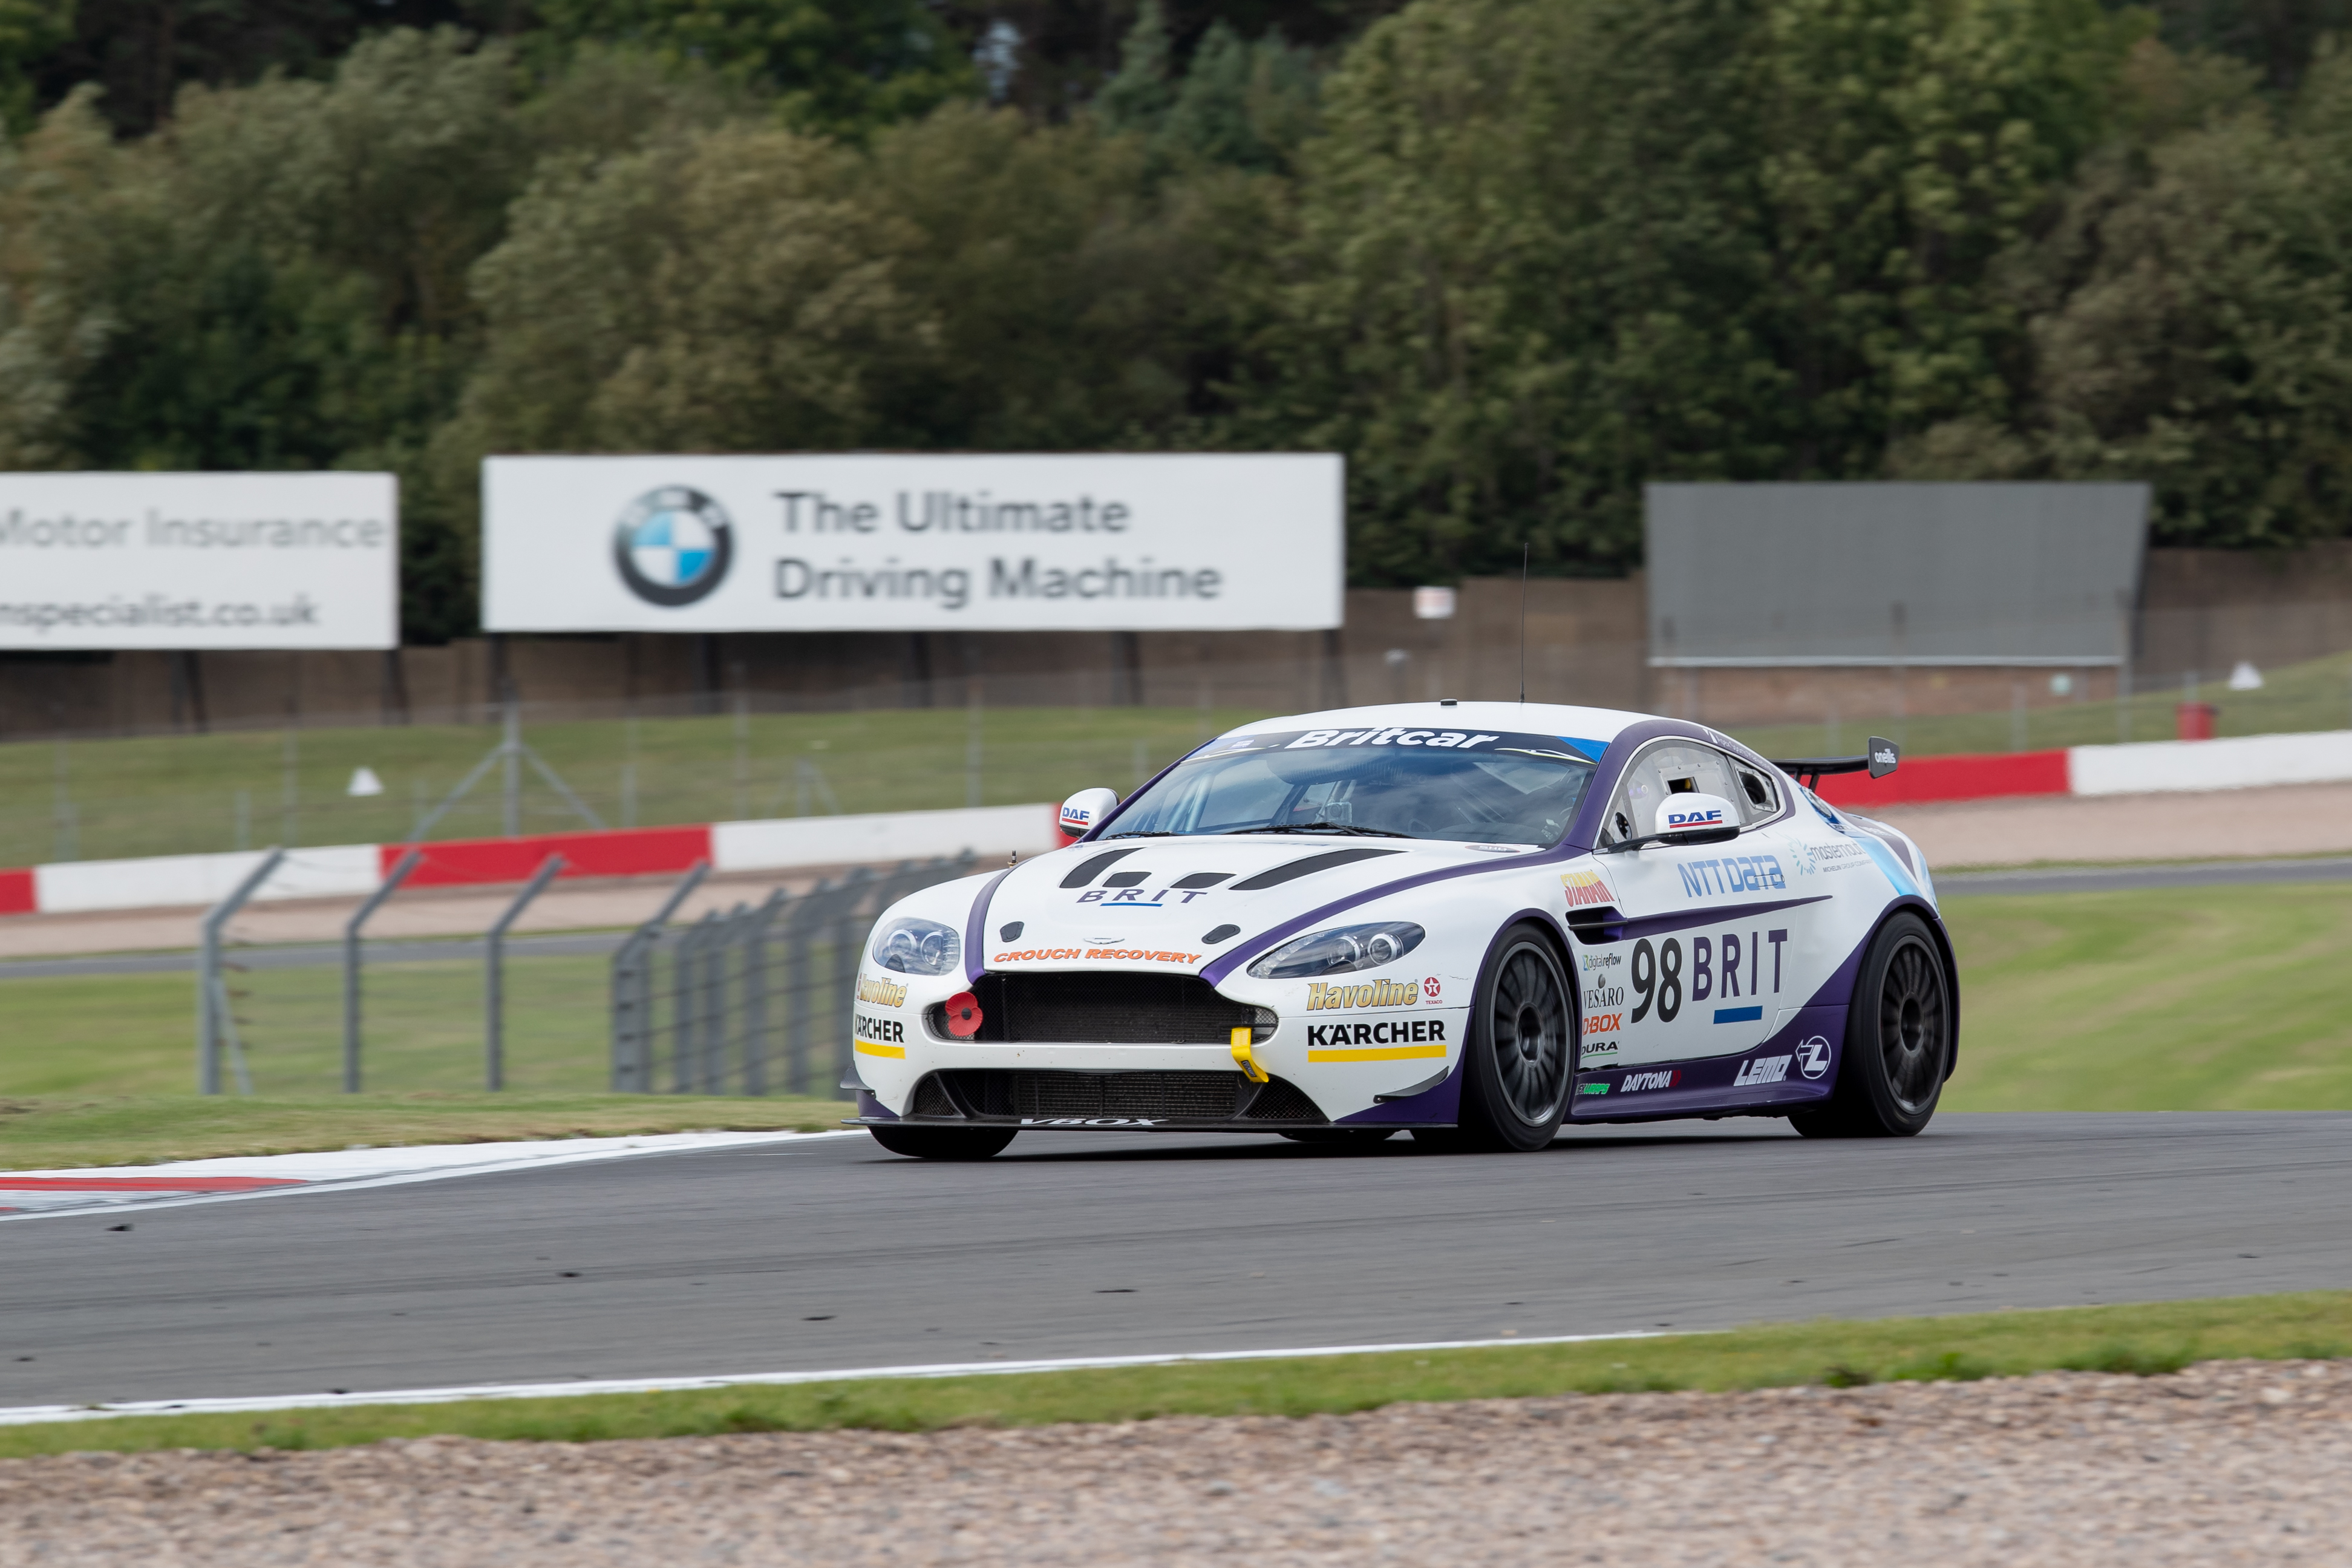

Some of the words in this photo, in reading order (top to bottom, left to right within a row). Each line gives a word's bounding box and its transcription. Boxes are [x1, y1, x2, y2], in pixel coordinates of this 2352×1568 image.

[775, 489, 878, 533] The
[897, 489, 1129, 533] Ultimate
[145, 508, 385, 548] Insurance
[775, 557, 968, 609] Driving
[988, 557, 1223, 599] Machine
[1284, 727, 1500, 749] Britcar
[1062, 806, 1090, 820] DAF
[1668, 809, 1722, 824] DAF
[1677, 859, 1725, 898] NTT
[1076, 889, 1207, 903] BRIT
[994, 949, 1081, 962] CROUCH
[1085, 949, 1201, 964] RECOVERY
[1692, 929, 1788, 1001] BRIT
[1307, 979, 1419, 1011] Havoline
[1630, 938, 1682, 1024] 98
[1583, 987, 1624, 1010] VESARO
[1307, 1020, 1446, 1047] KÄRCHER
[1620, 1070, 1672, 1093] DAYTONA
[1733, 1054, 1792, 1086] LEMO
